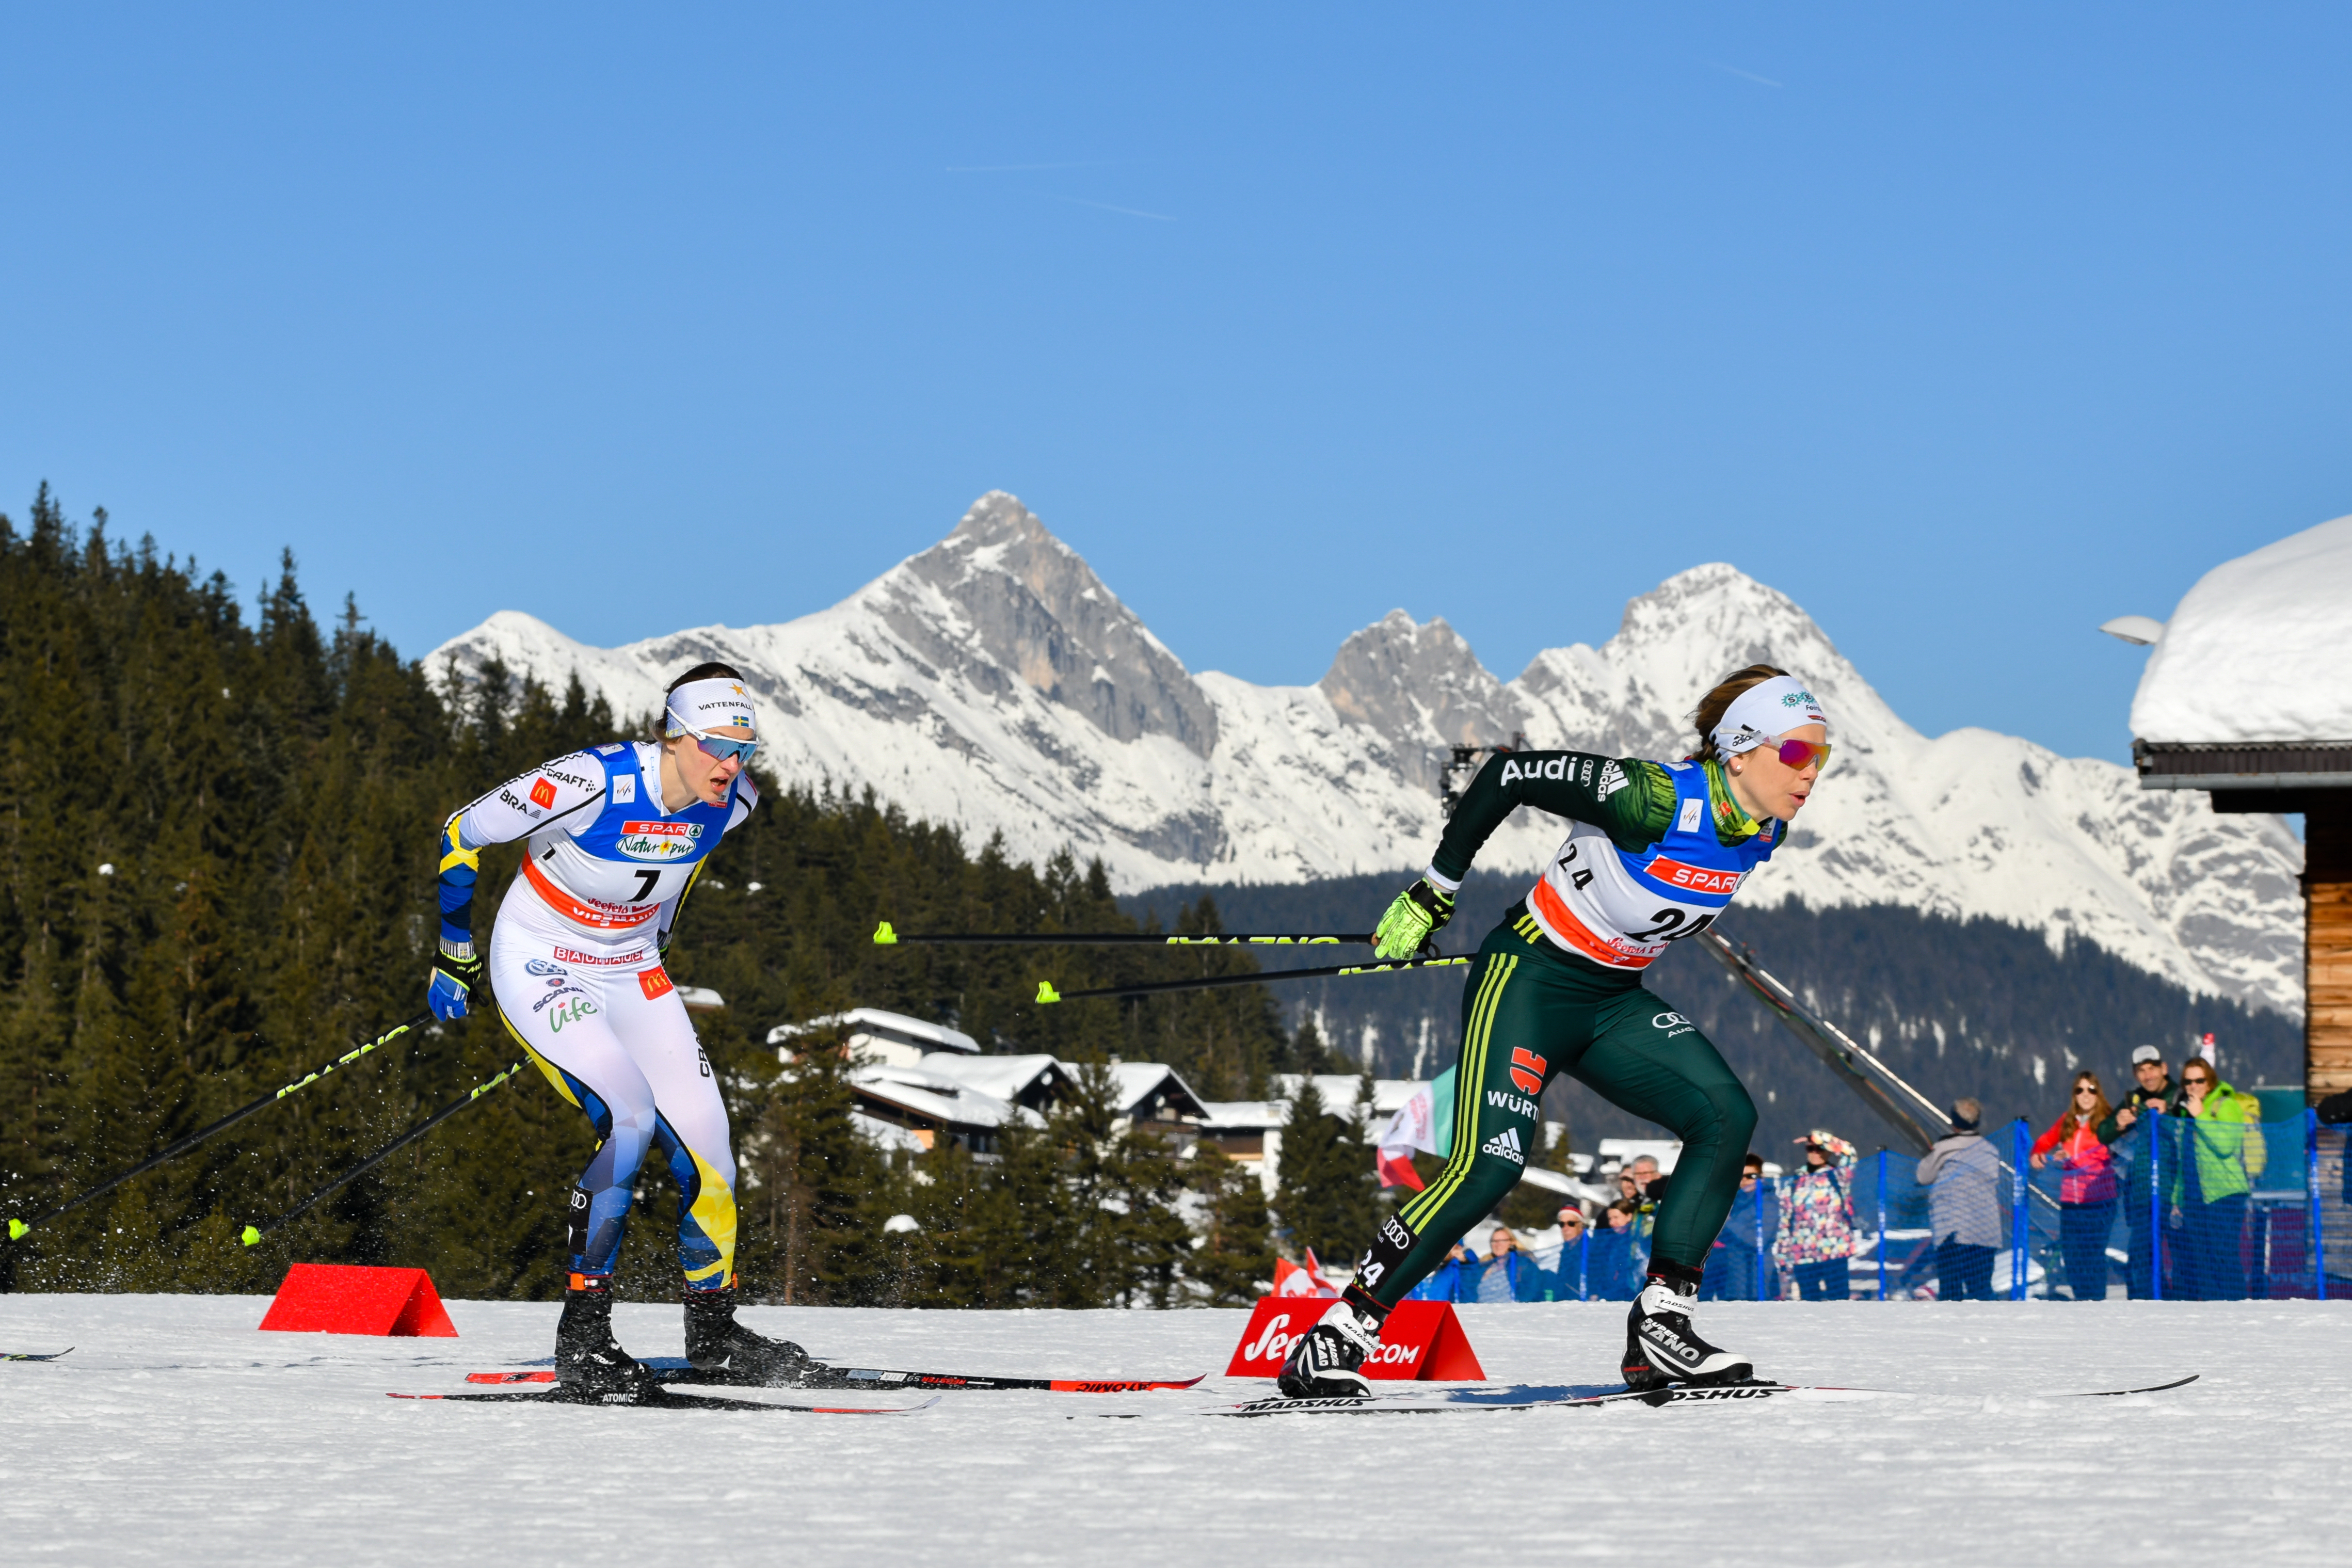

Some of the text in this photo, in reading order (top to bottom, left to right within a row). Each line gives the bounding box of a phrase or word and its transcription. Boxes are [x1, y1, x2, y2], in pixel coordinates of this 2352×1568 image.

[698, 701, 752, 711] VATTENFALL
[546, 767, 587, 788] CRAFT
[1501, 755, 1578, 786] Audi
[1597, 760, 1615, 802] adidas
[500, 789, 527, 814] BRA
[638, 824, 687, 834] SPAR
[620, 836, 694, 857] Natur pur
[1558, 843, 1594, 891] 24
[626, 870, 661, 902] 7
[1672, 869, 1737, 890] SPAR
[1482, 1144, 1524, 1165] adidas
[1644, 1317, 1680, 1341] SUPER
[765, 1380, 807, 1389] ATOMIC
[1670, 1388, 1794, 1401] DSHUS
[602, 1393, 634, 1403] ATOMIC
[1241, 1399, 1377, 1413] MADSHUS
